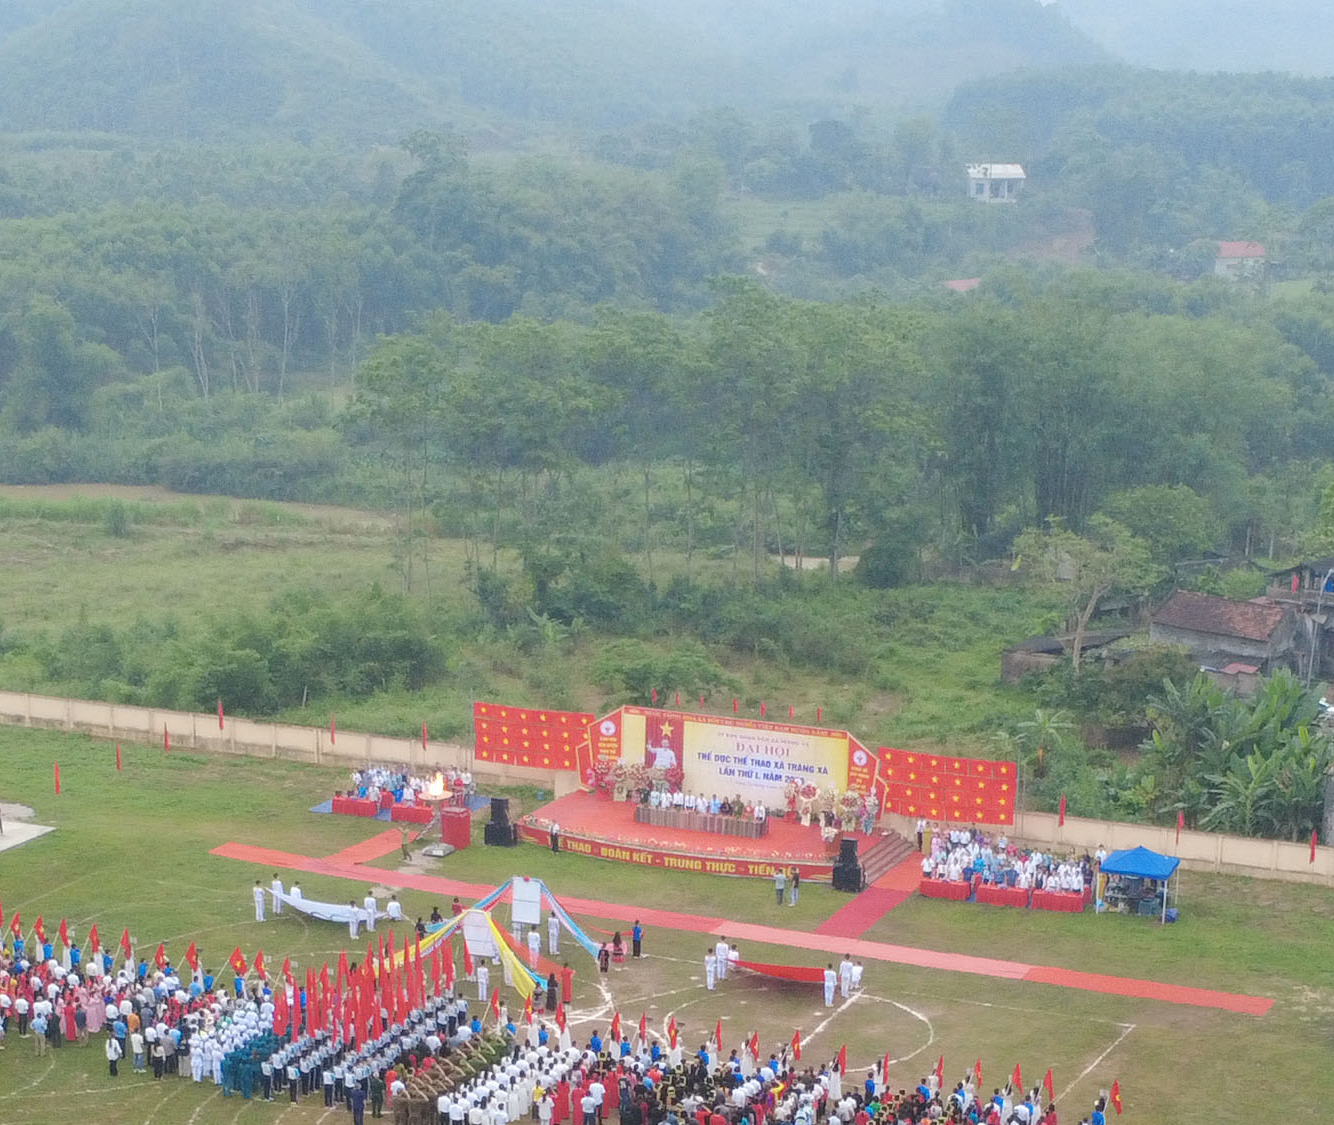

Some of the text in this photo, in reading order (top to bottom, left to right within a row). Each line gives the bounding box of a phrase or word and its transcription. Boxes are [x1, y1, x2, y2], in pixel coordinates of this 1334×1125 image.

[750, 758, 771, 769] THAO
[548, 835, 563, 848] TỂ
[567, 840, 591, 853] THAO
[663, 857, 702, 870] TRUNG
